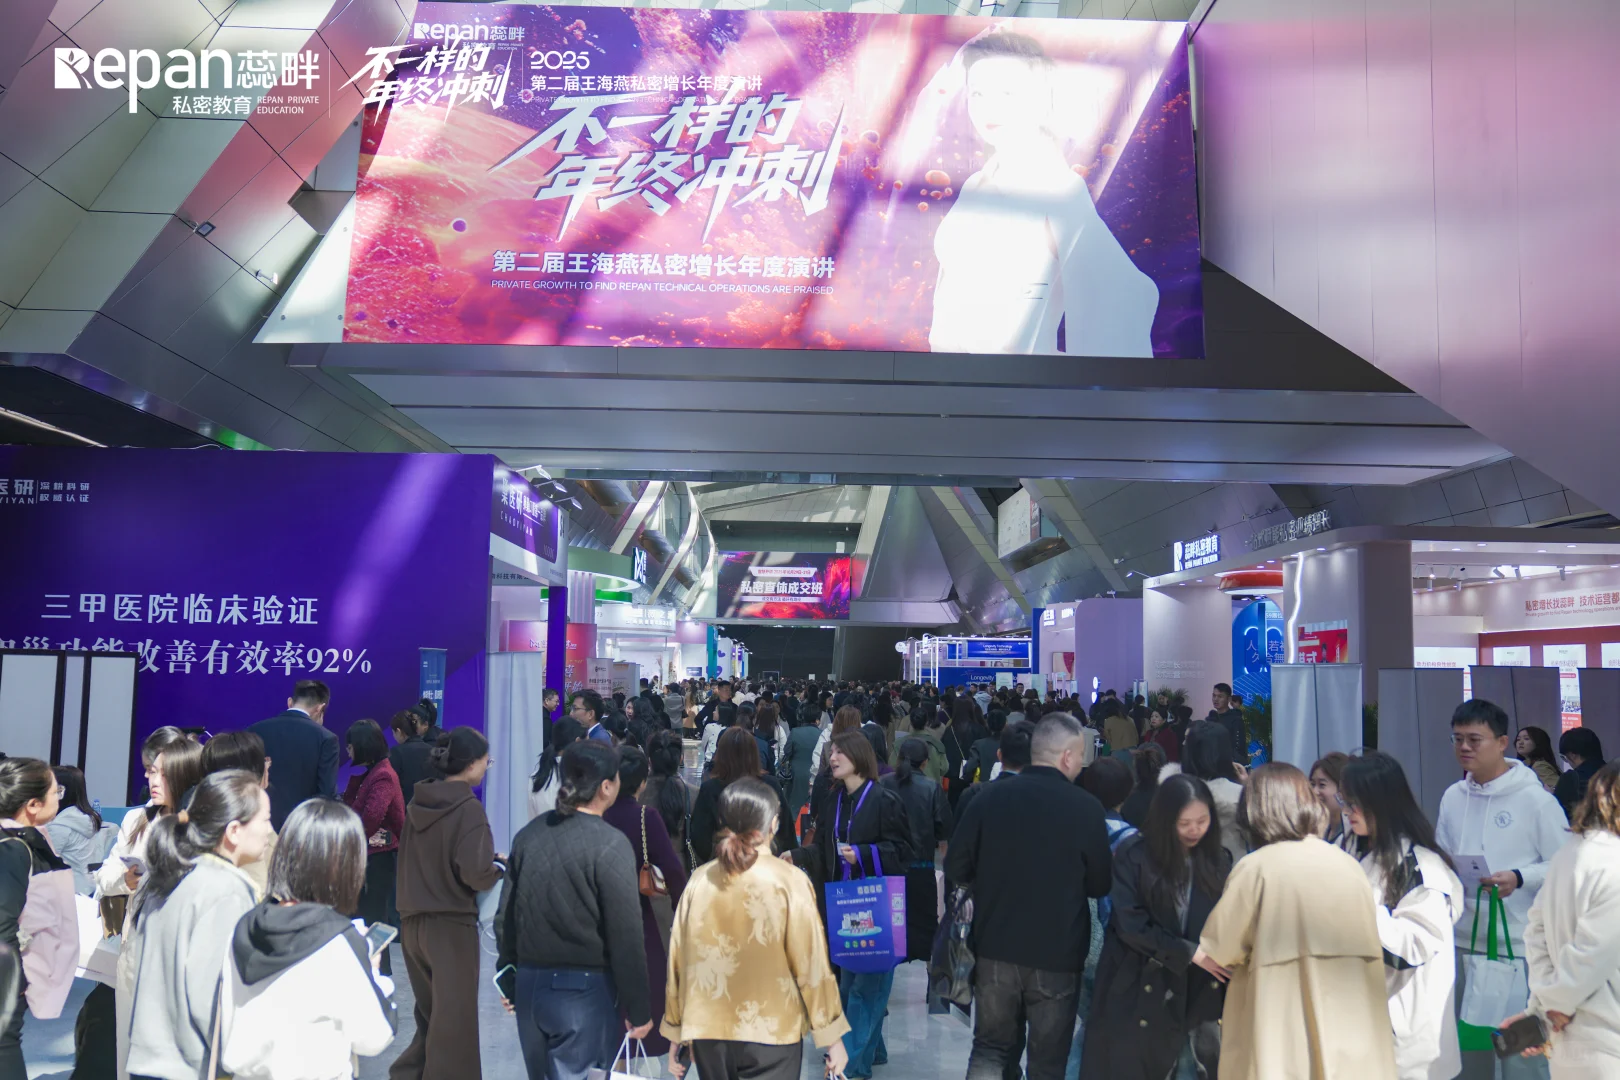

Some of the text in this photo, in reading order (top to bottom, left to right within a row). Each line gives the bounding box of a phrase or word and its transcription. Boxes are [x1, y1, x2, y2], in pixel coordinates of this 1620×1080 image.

[490, 26, 525, 41] 蕊畔
[487, 76, 802, 174] 不一样的
[534, 102, 845, 244] 年终冲刺
[492, 250, 836, 278] 第二届王海燕私密增长年度演讲
[491, 279, 834, 295] PRIVATE GROWTH TO FIND REPAN TECHNICAL OPERATIONS ARE PRAISED
[41, 592, 319, 626] 三甲医院临床验证
